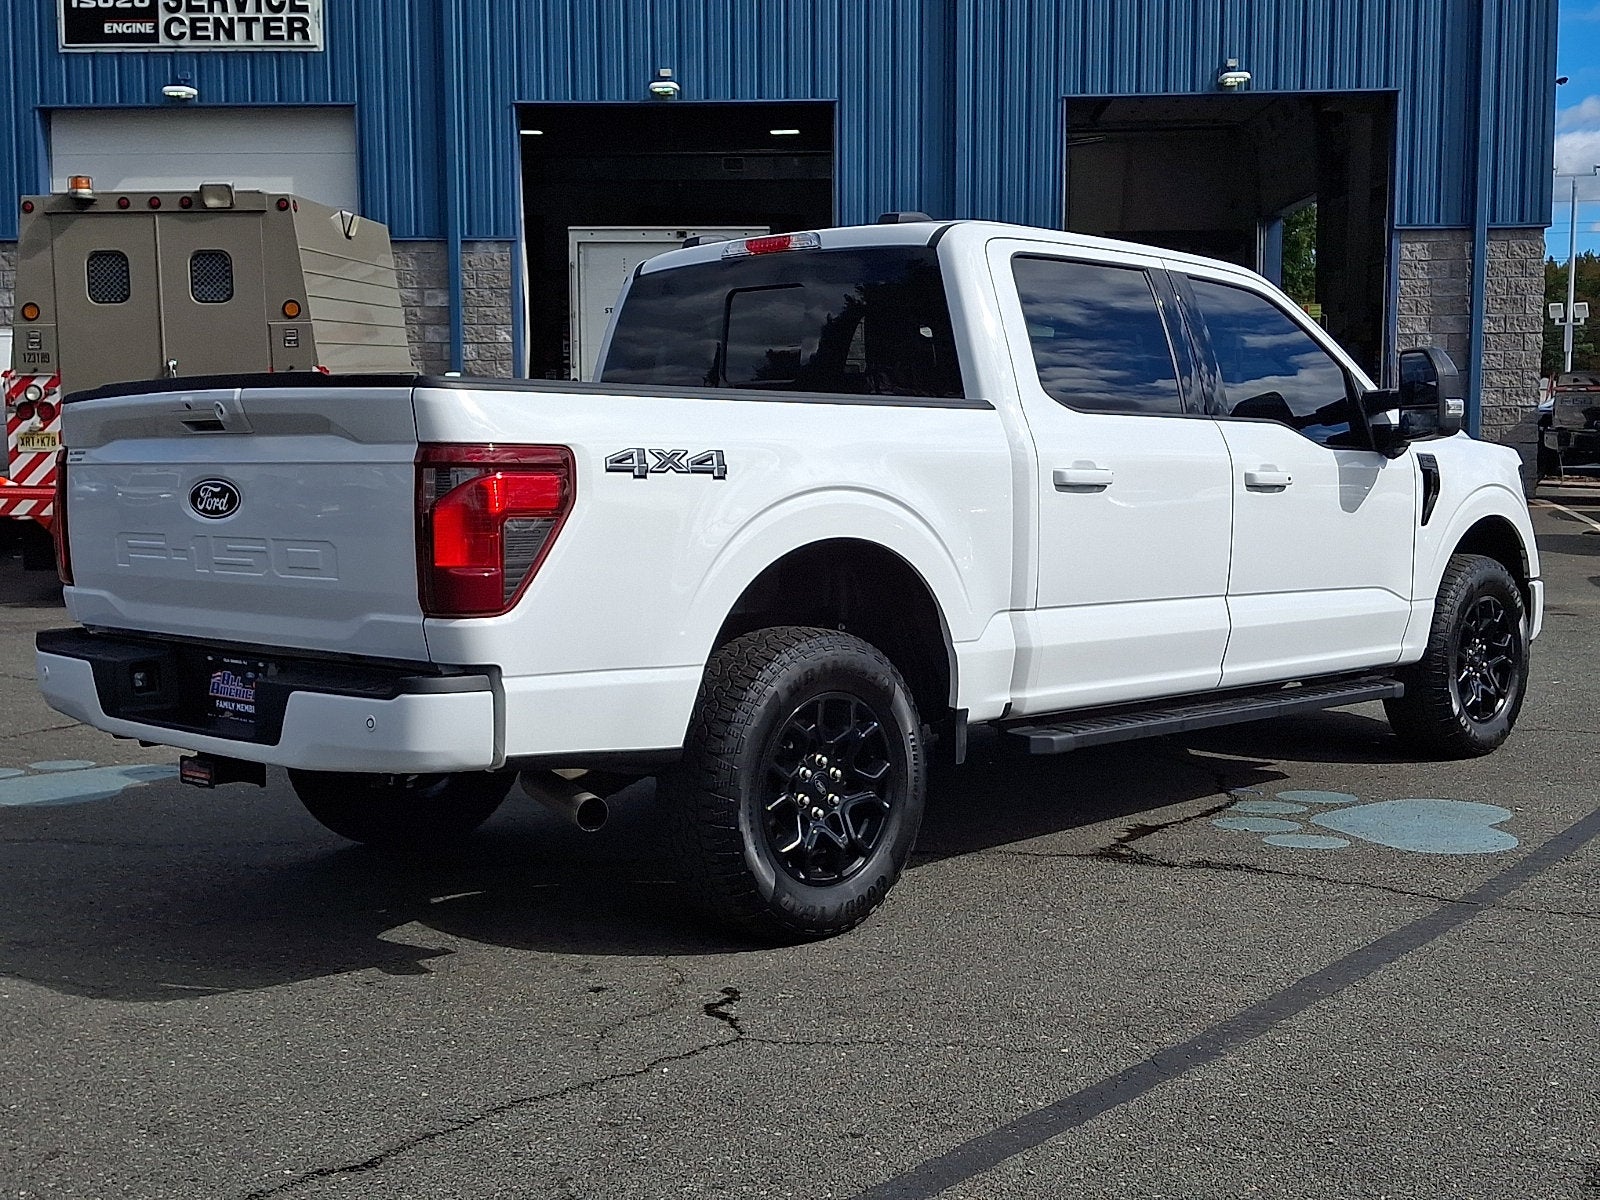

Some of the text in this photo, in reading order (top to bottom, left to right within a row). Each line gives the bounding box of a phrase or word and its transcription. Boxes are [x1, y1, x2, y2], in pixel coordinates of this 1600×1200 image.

[163, 0, 310, 13] SERVICE
[104, 22, 155, 34] ENGINE
[163, 16, 311, 41] CENTER
[197, 485, 230, 511] Ford
[115, 531, 339, 581] F-150
[215, 699, 236, 711] FAMILY
